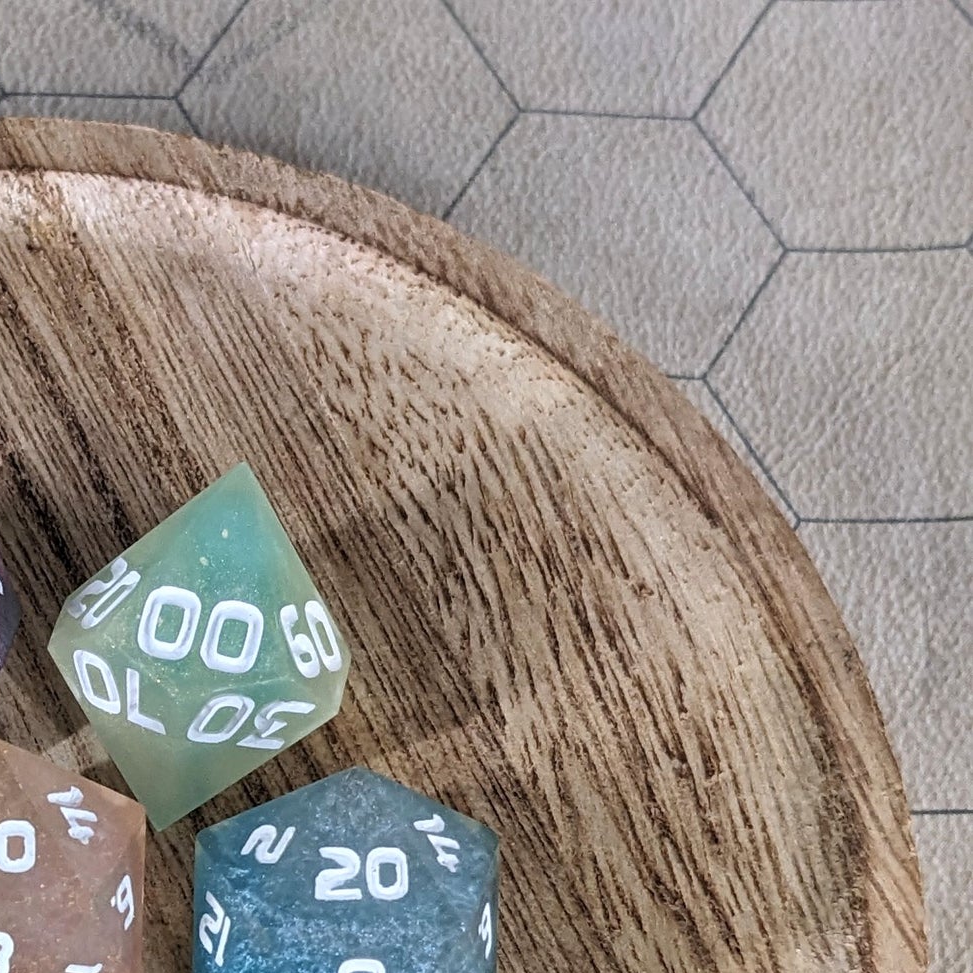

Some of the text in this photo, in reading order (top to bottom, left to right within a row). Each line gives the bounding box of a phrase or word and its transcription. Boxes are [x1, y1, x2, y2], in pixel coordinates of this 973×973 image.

[67, 556, 142, 630] 20
[137, 585, 265, 674] 00
[280, 600, 352, 679] 60
[47, 786, 98, 845] 14
[240, 823, 297, 865] 2
[413, 813, 461, 873] 14
[314, 846, 410, 901] 20
